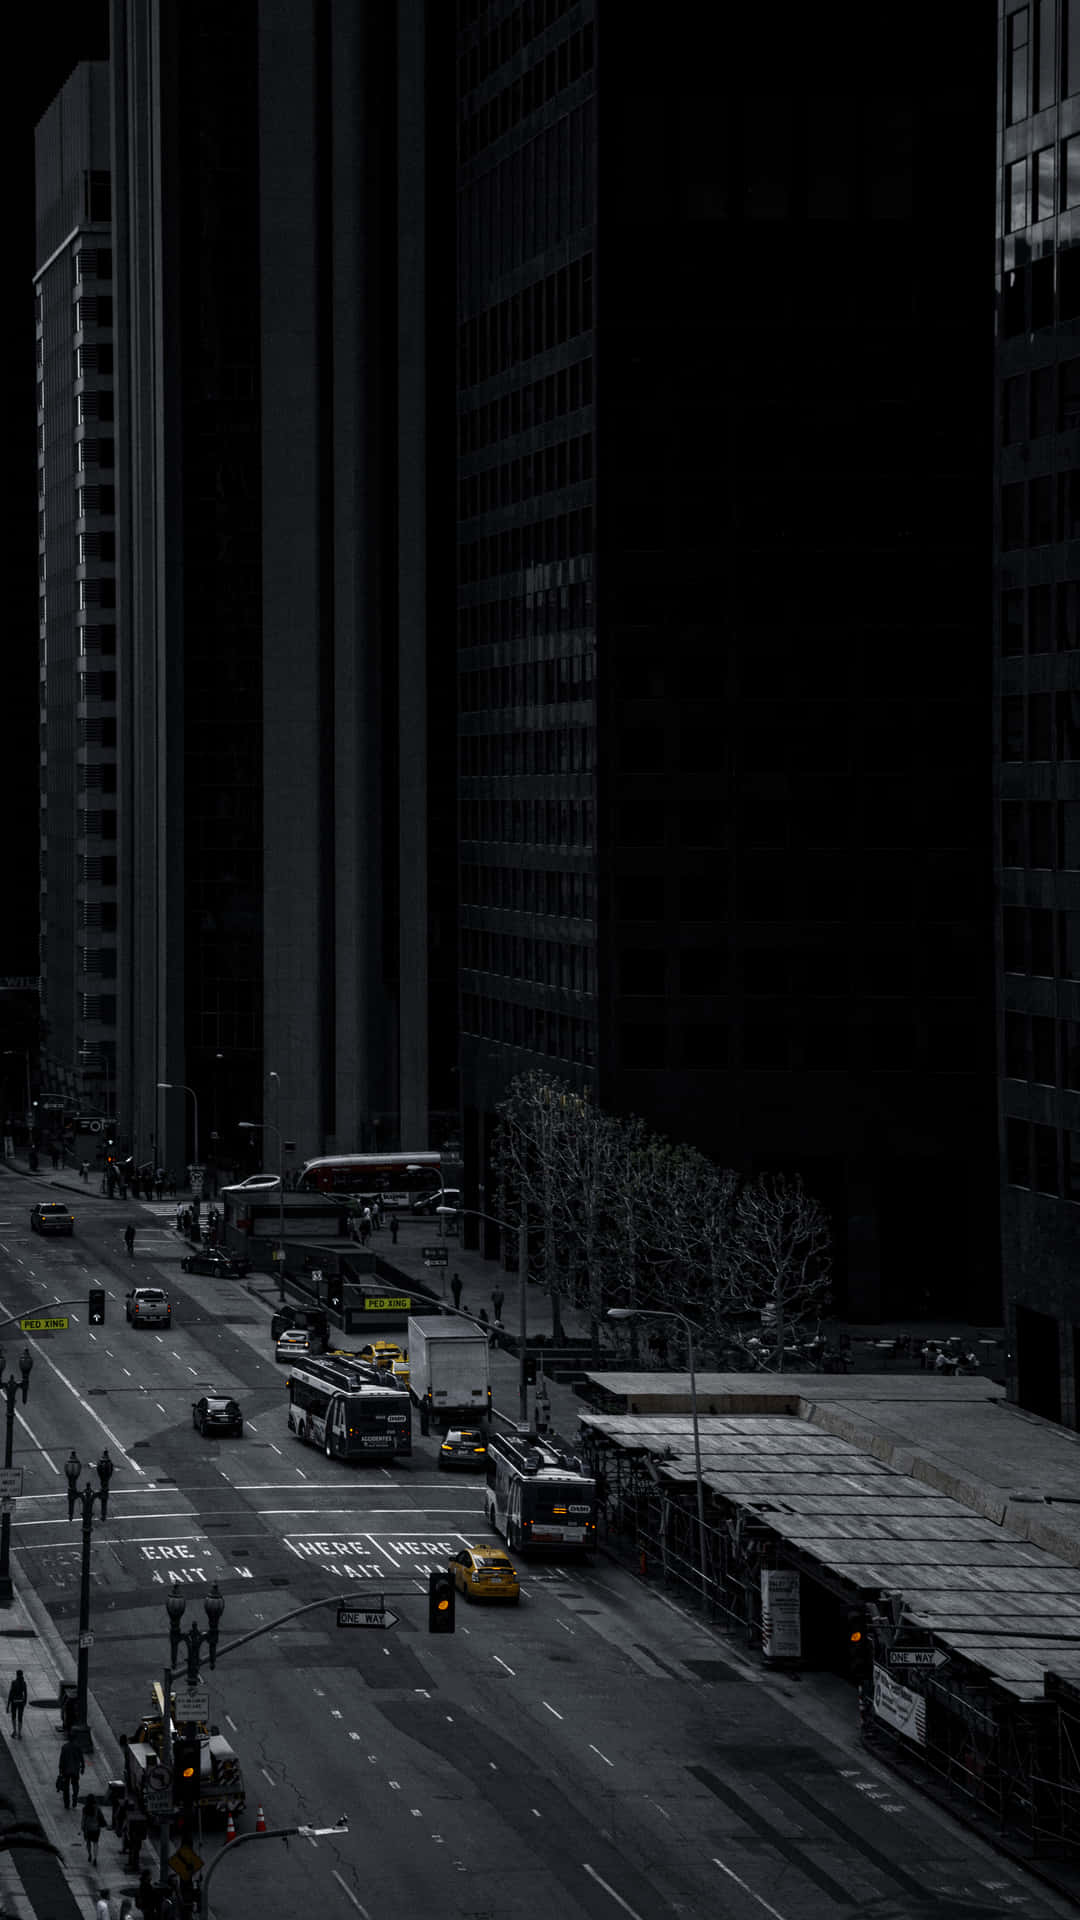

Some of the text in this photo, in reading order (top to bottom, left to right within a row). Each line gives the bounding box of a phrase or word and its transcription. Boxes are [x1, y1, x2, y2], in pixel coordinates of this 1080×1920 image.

[23, 1319, 65, 1329] PED XING
[297, 1541, 371, 1556] HERE
[388, 1541, 458, 1556] HERE
[340, 1613, 385, 1624] ONE WAY
[891, 1653, 934, 1662] ONE WAY
